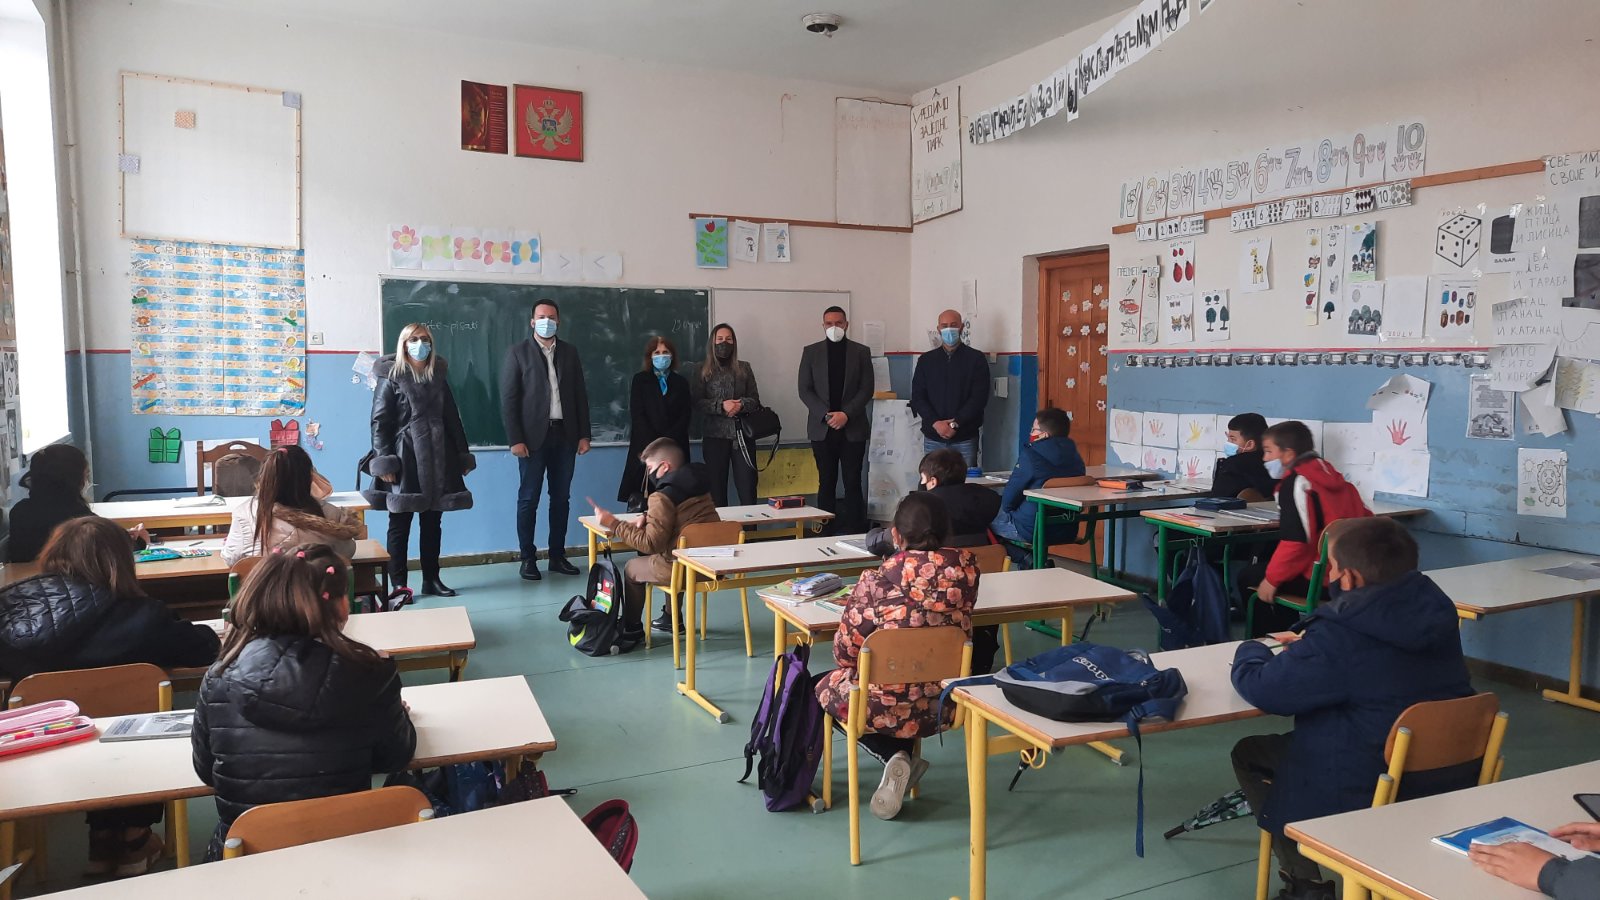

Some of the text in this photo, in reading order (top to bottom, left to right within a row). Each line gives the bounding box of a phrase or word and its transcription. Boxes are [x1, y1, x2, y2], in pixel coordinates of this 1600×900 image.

[1397, 123, 1425, 153] 10
[1316, 139, 1332, 183] 8
[1353, 133, 1365, 177] 9
[1549, 155, 1570, 168] СВЕ
[1254, 152, 1268, 193] 6
[1285, 148, 1301, 188] 7
[1550, 168, 1586, 185] СВОЈЕ
[1226, 161, 1239, 199] 5
[1525, 216, 1560, 228] ПТИЦА
[1516, 234, 1523, 244] И
[1513, 279, 1522, 290] И
[1497, 328, 1505, 336] И
